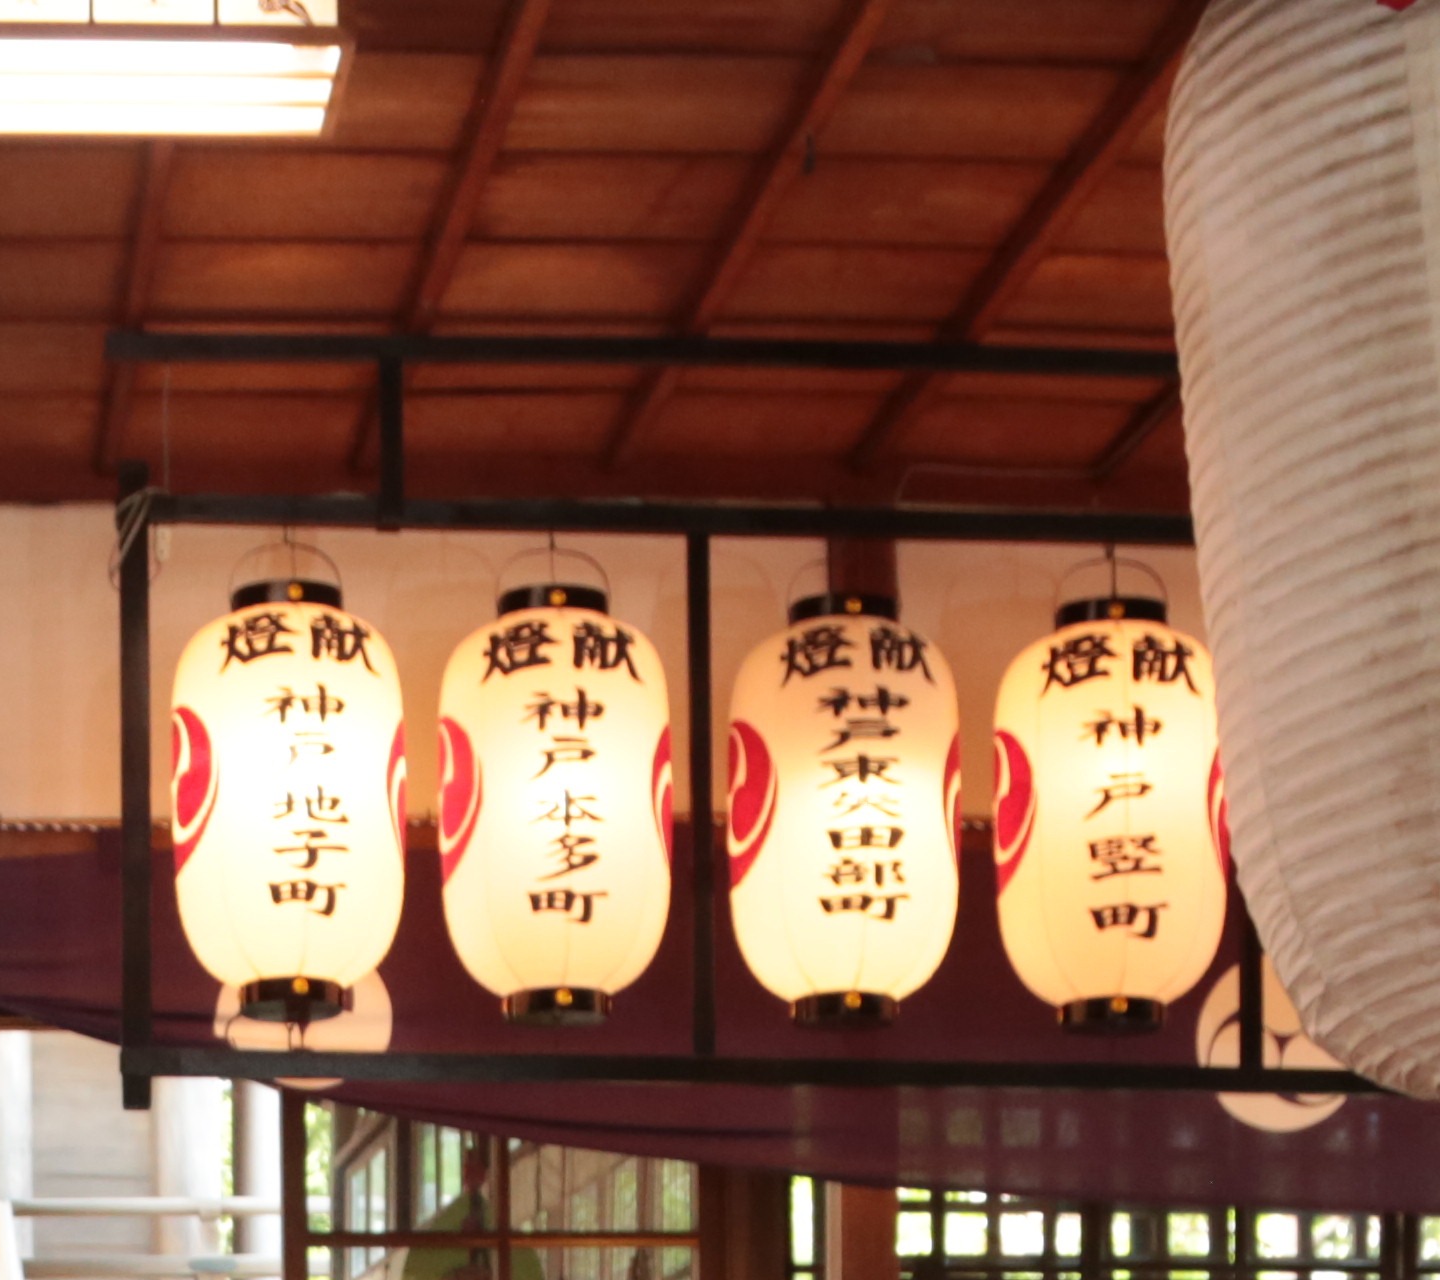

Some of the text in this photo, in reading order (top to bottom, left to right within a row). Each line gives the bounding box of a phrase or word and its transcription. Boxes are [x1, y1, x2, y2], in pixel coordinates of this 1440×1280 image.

[263, 683, 351, 916] 神戸地子町
[521, 686, 610, 923] 神戸本多町
